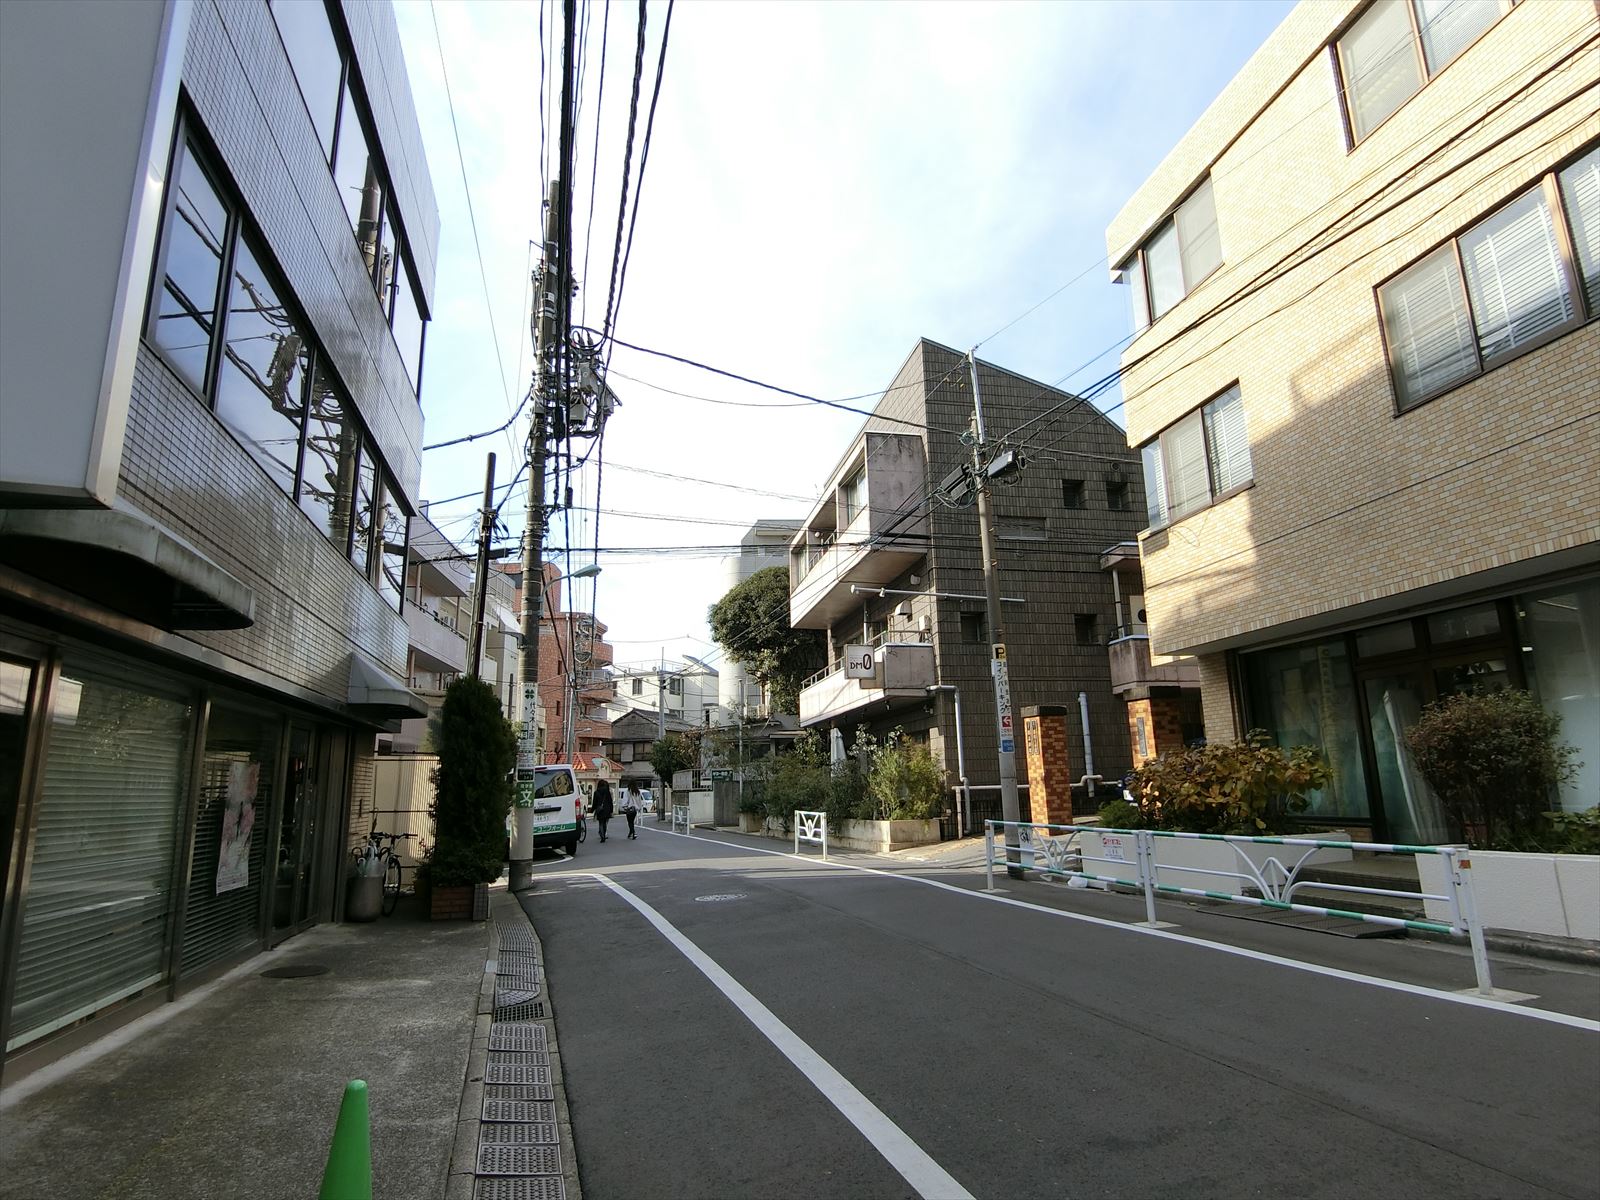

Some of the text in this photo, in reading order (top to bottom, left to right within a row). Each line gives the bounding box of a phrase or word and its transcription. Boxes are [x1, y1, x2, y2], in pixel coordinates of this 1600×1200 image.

[995, 647, 1004, 659] P
[996, 661, 1006, 714] コインパーキング
[520, 789, 532, 807] 文
